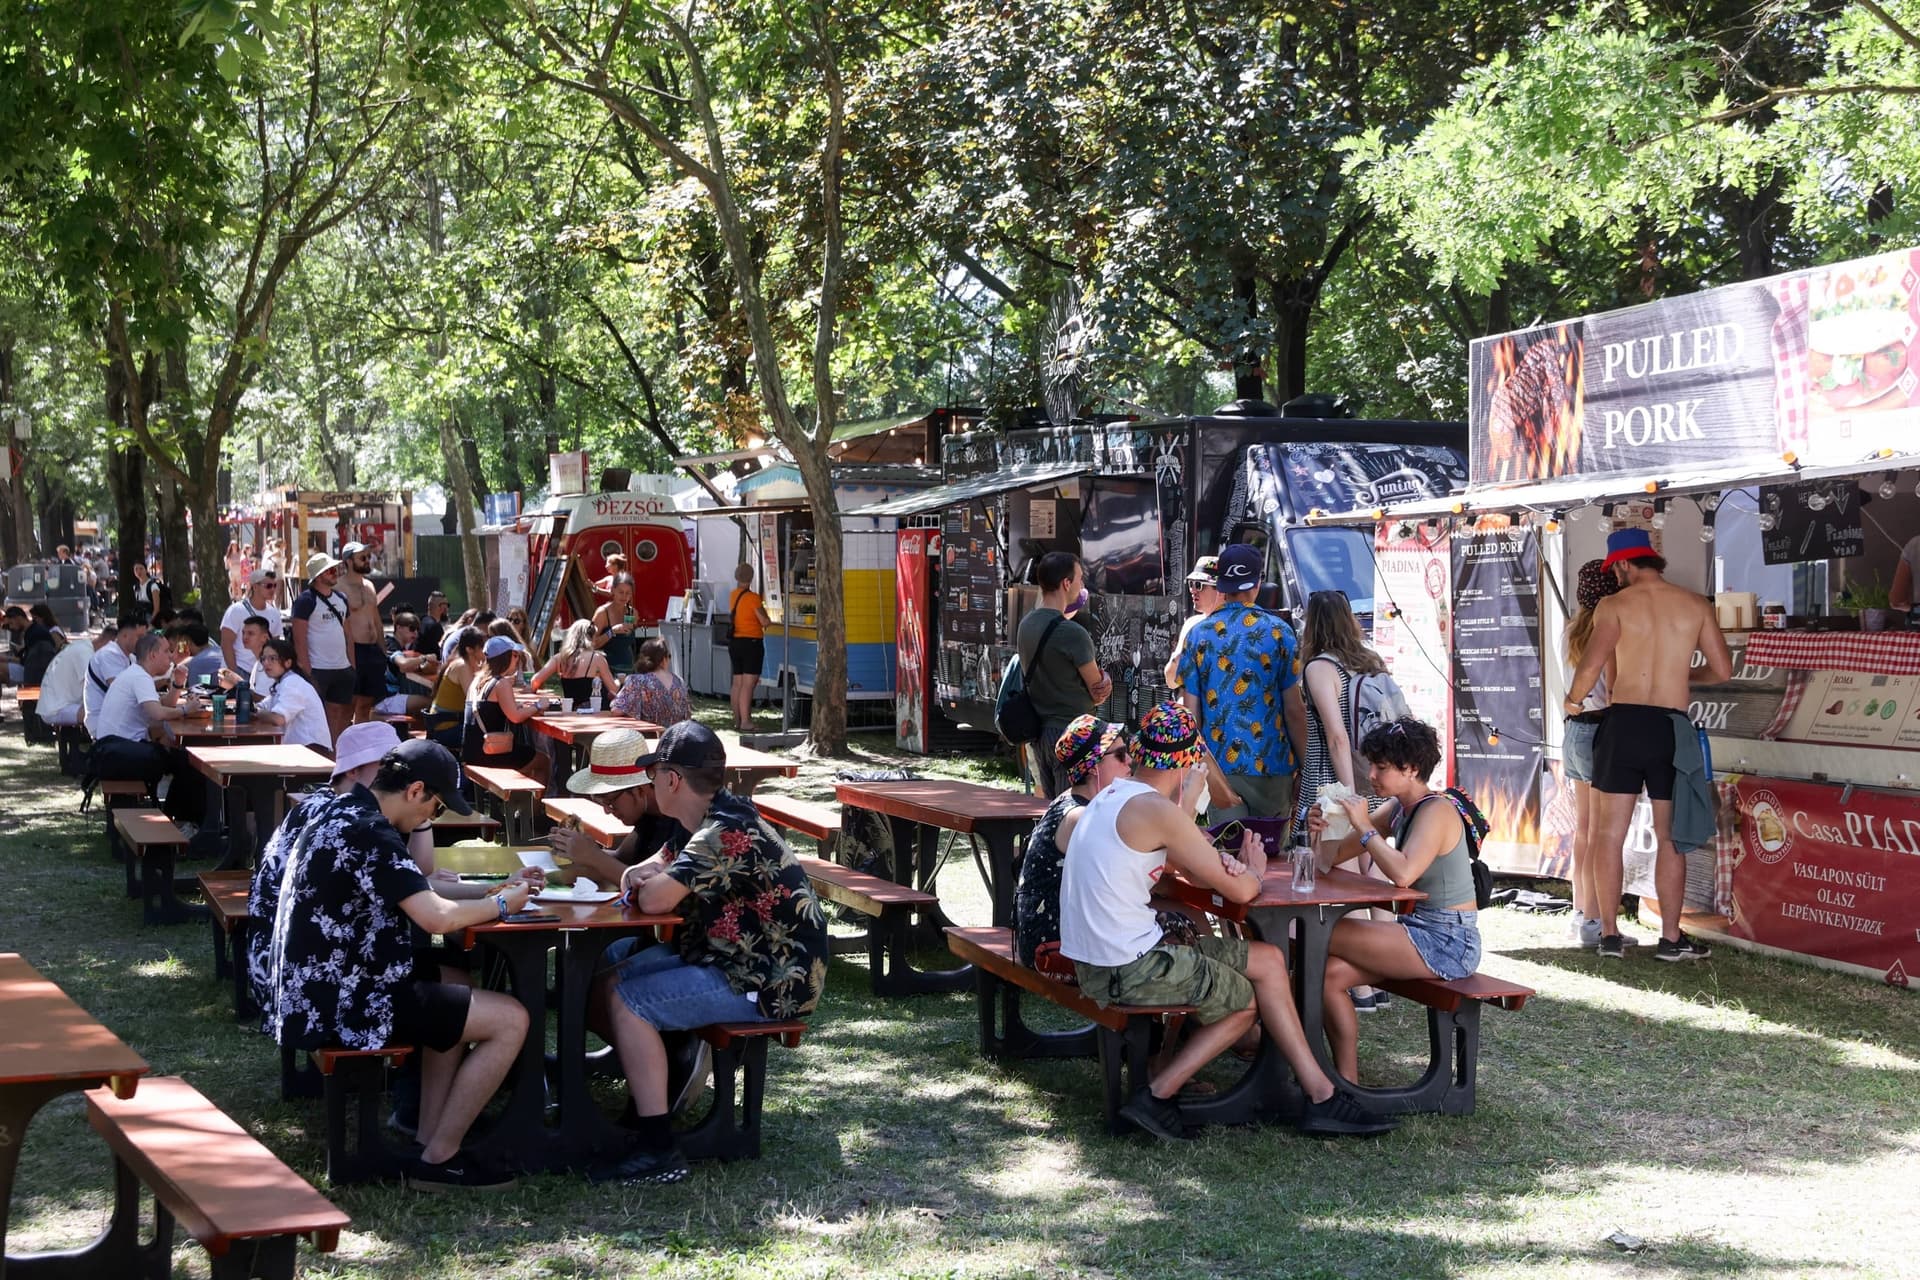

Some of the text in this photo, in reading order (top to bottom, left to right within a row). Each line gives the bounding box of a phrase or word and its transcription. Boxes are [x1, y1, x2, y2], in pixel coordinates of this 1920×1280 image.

[1602, 321, 1745, 383] PULLED
[1602, 397, 1706, 450] PORK
[1461, 540, 1524, 557] PULLED PORK
[1381, 559, 1421, 573] PIADINA
[1792, 810, 1848, 845] Casa
[1793, 861, 1887, 892] VASLAPON SÜLT
[1817, 888, 1856, 909] OLASZ
[1781, 902, 1885, 936] LEPÉNYKENYEREK
